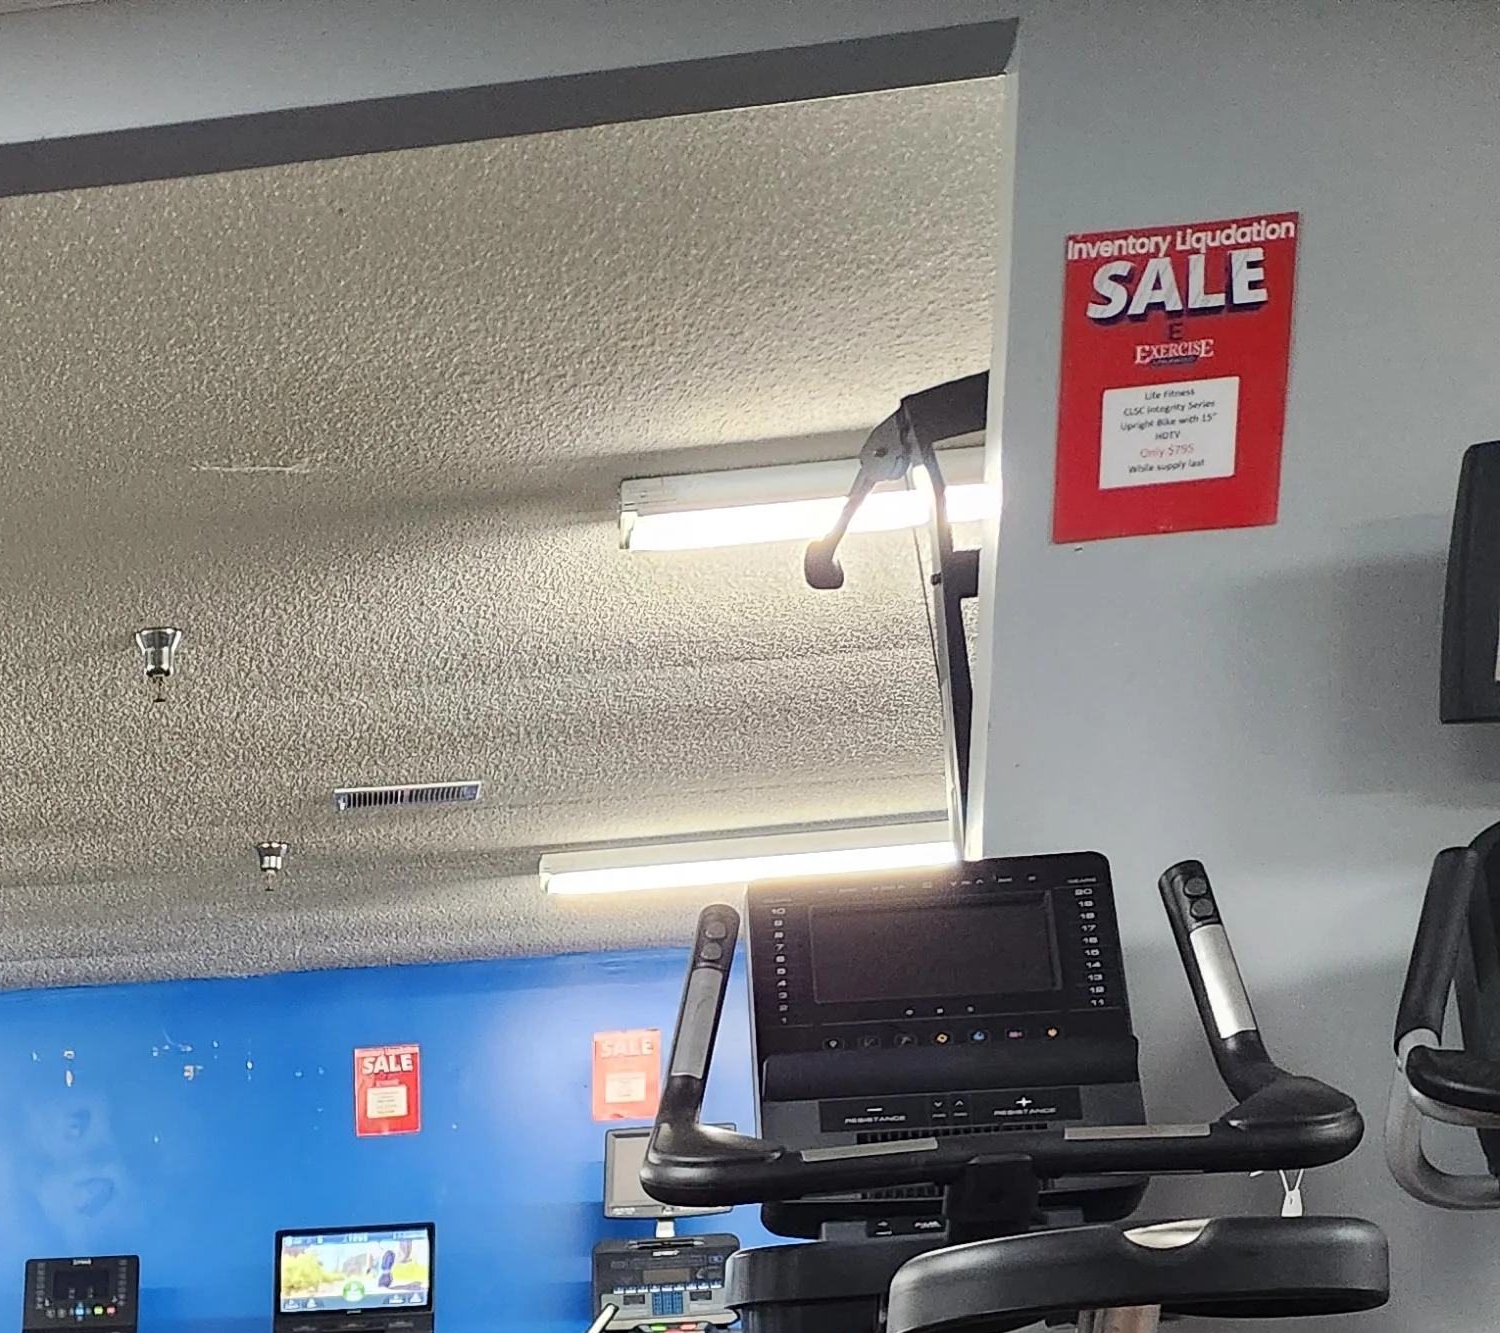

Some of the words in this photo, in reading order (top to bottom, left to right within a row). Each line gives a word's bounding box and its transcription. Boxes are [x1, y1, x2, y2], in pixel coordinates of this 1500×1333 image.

[1067, 234, 1171, 259] Inventory
[1175, 219, 1295, 254] Liqudation
[1086, 246, 1269, 322] SALE
[1134, 338, 1215, 365] EXERCISE
[1163, 388, 1195, 399] Fitness
[1156, 460, 1186, 472] supply
[1188, 458, 1205, 468] last
[600, 1037, 654, 1059] SALE
[361, 1053, 414, 1076] SALE
